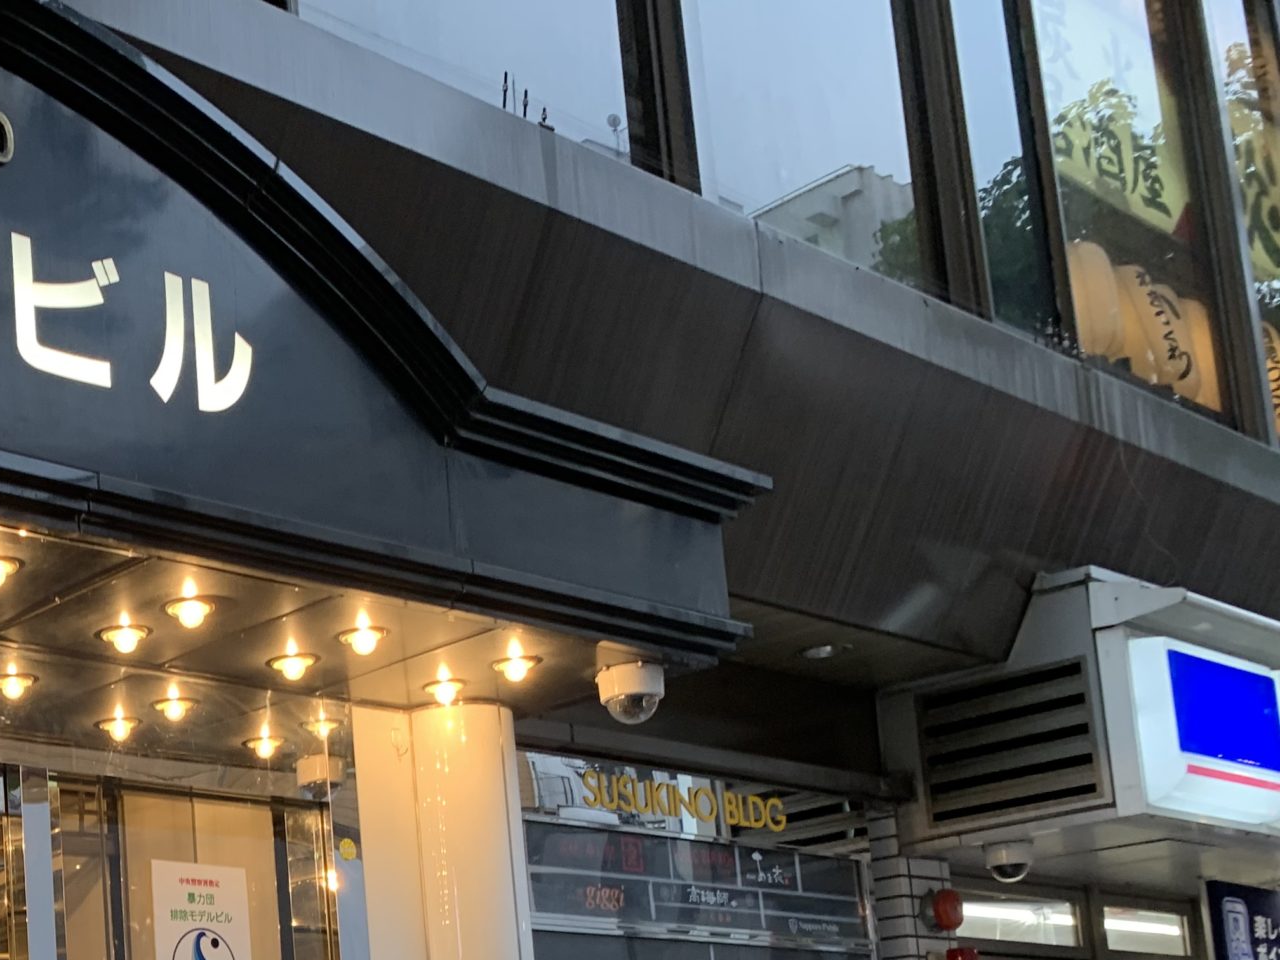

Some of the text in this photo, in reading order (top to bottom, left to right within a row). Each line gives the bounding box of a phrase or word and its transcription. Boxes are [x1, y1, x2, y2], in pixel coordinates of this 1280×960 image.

[582, 769, 787, 832] SUSUKINO BLDG
[187, 893, 215, 906] 暴力団
[170, 909, 233, 924] 排除モデルビル
[1253, 914, 1280, 940] 楽し
